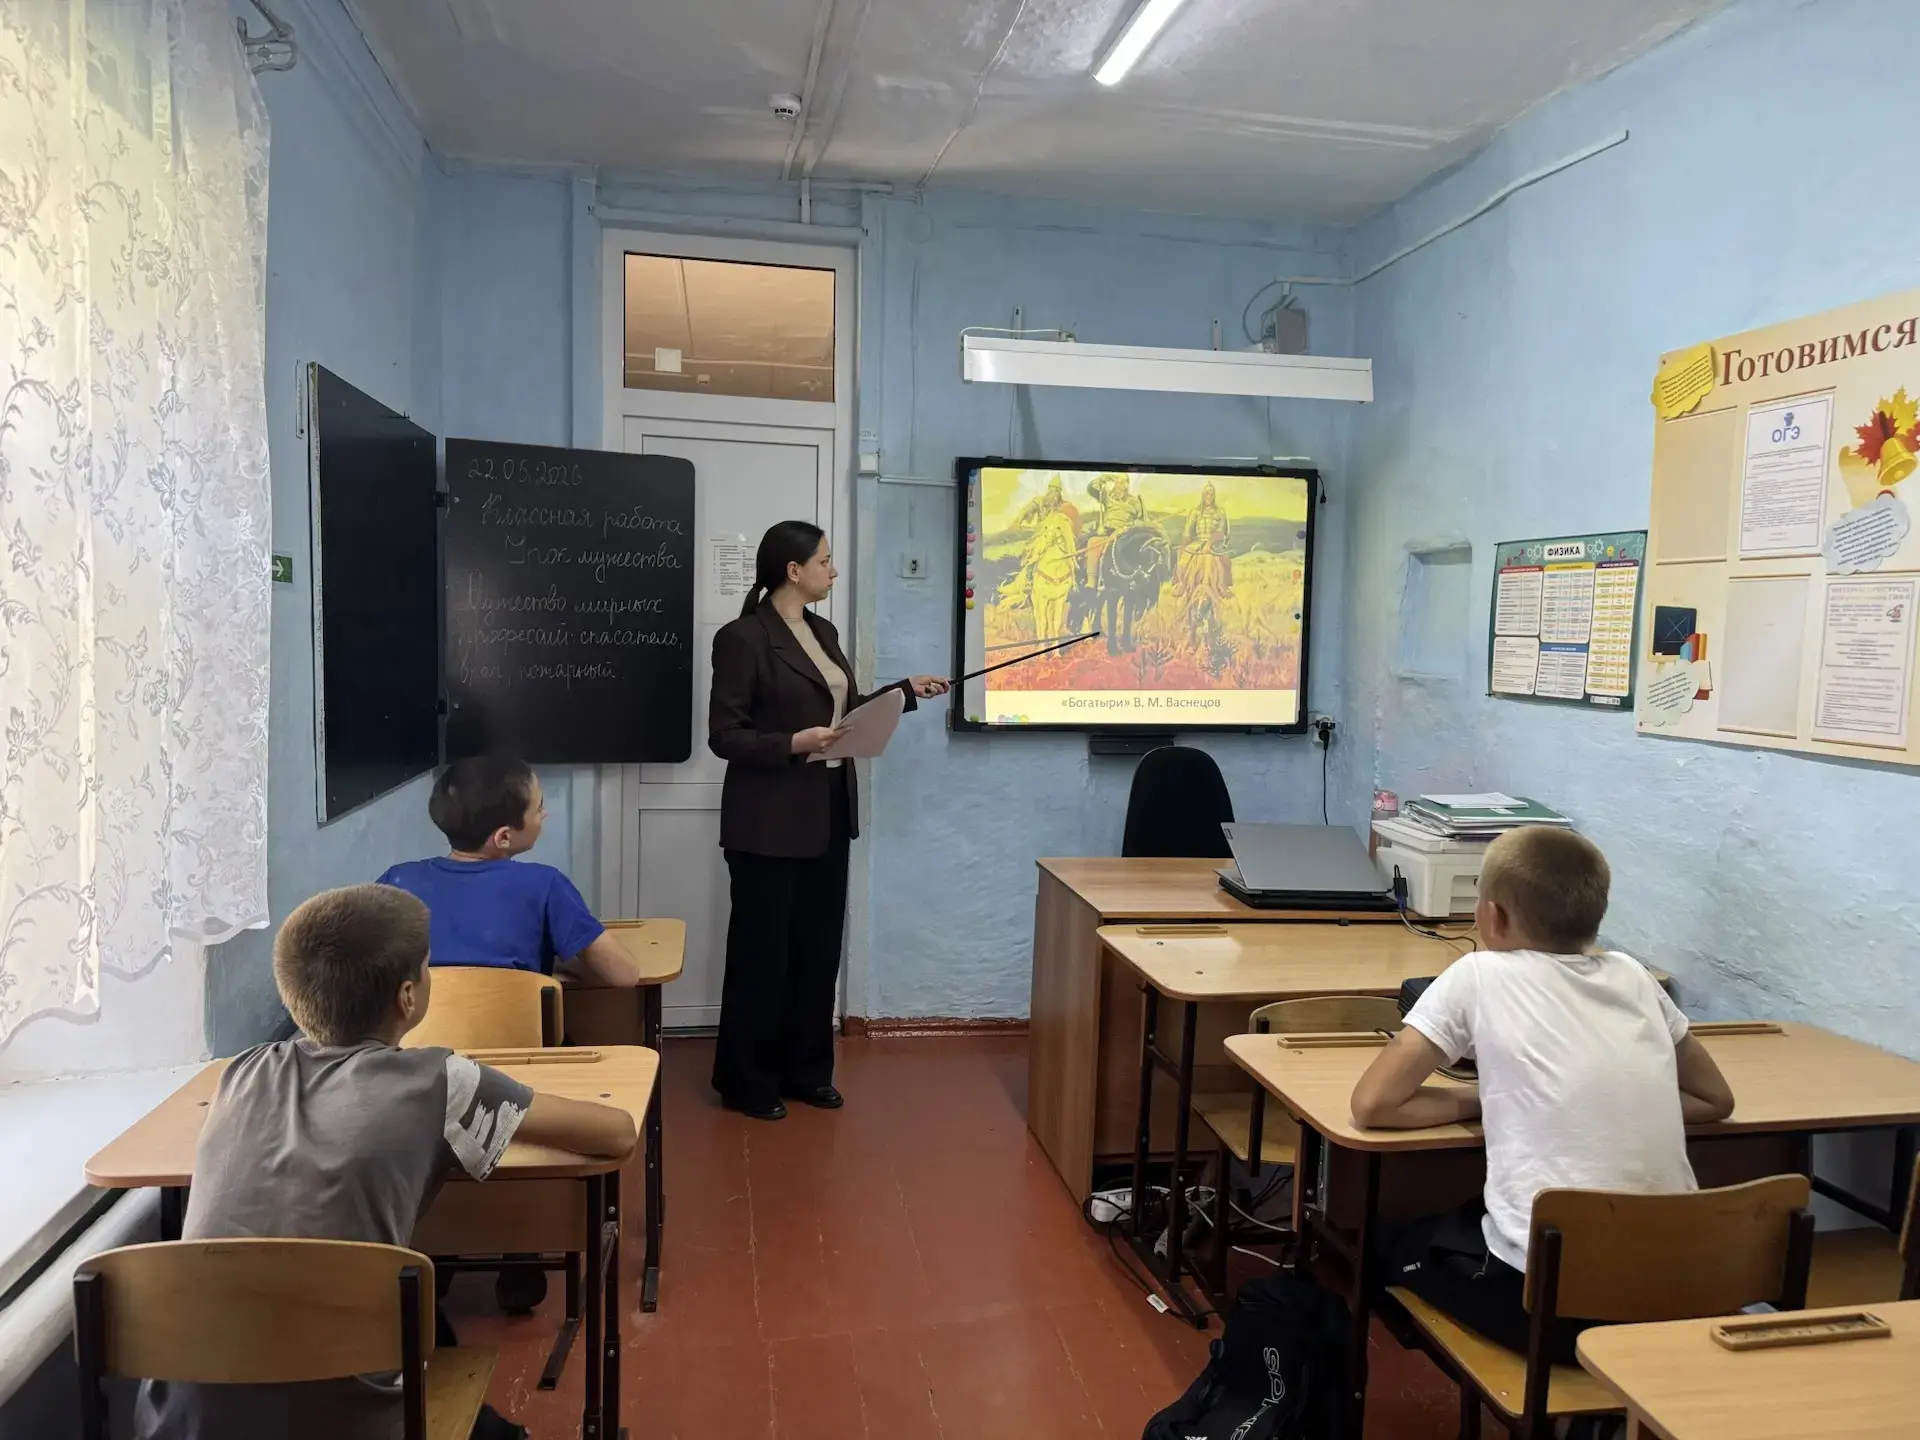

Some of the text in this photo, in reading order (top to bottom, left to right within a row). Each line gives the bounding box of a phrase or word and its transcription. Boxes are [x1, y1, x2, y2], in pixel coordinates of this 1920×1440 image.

[1771, 425, 1801, 443] ОГЭ
[467, 458, 583, 486] 22.05.2026
[482, 492, 684, 538] Классная работа
[505, 533, 571, 564] Урок
[578, 541, 683, 583] мужества
[1547, 545, 1581, 557] ФИЗИКА
[574, 597, 665, 625] мирных
[580, 625, 683, 650] спасатель,
[1061, 696, 1221, 710] «Богатыри» В. М. Васнецов
